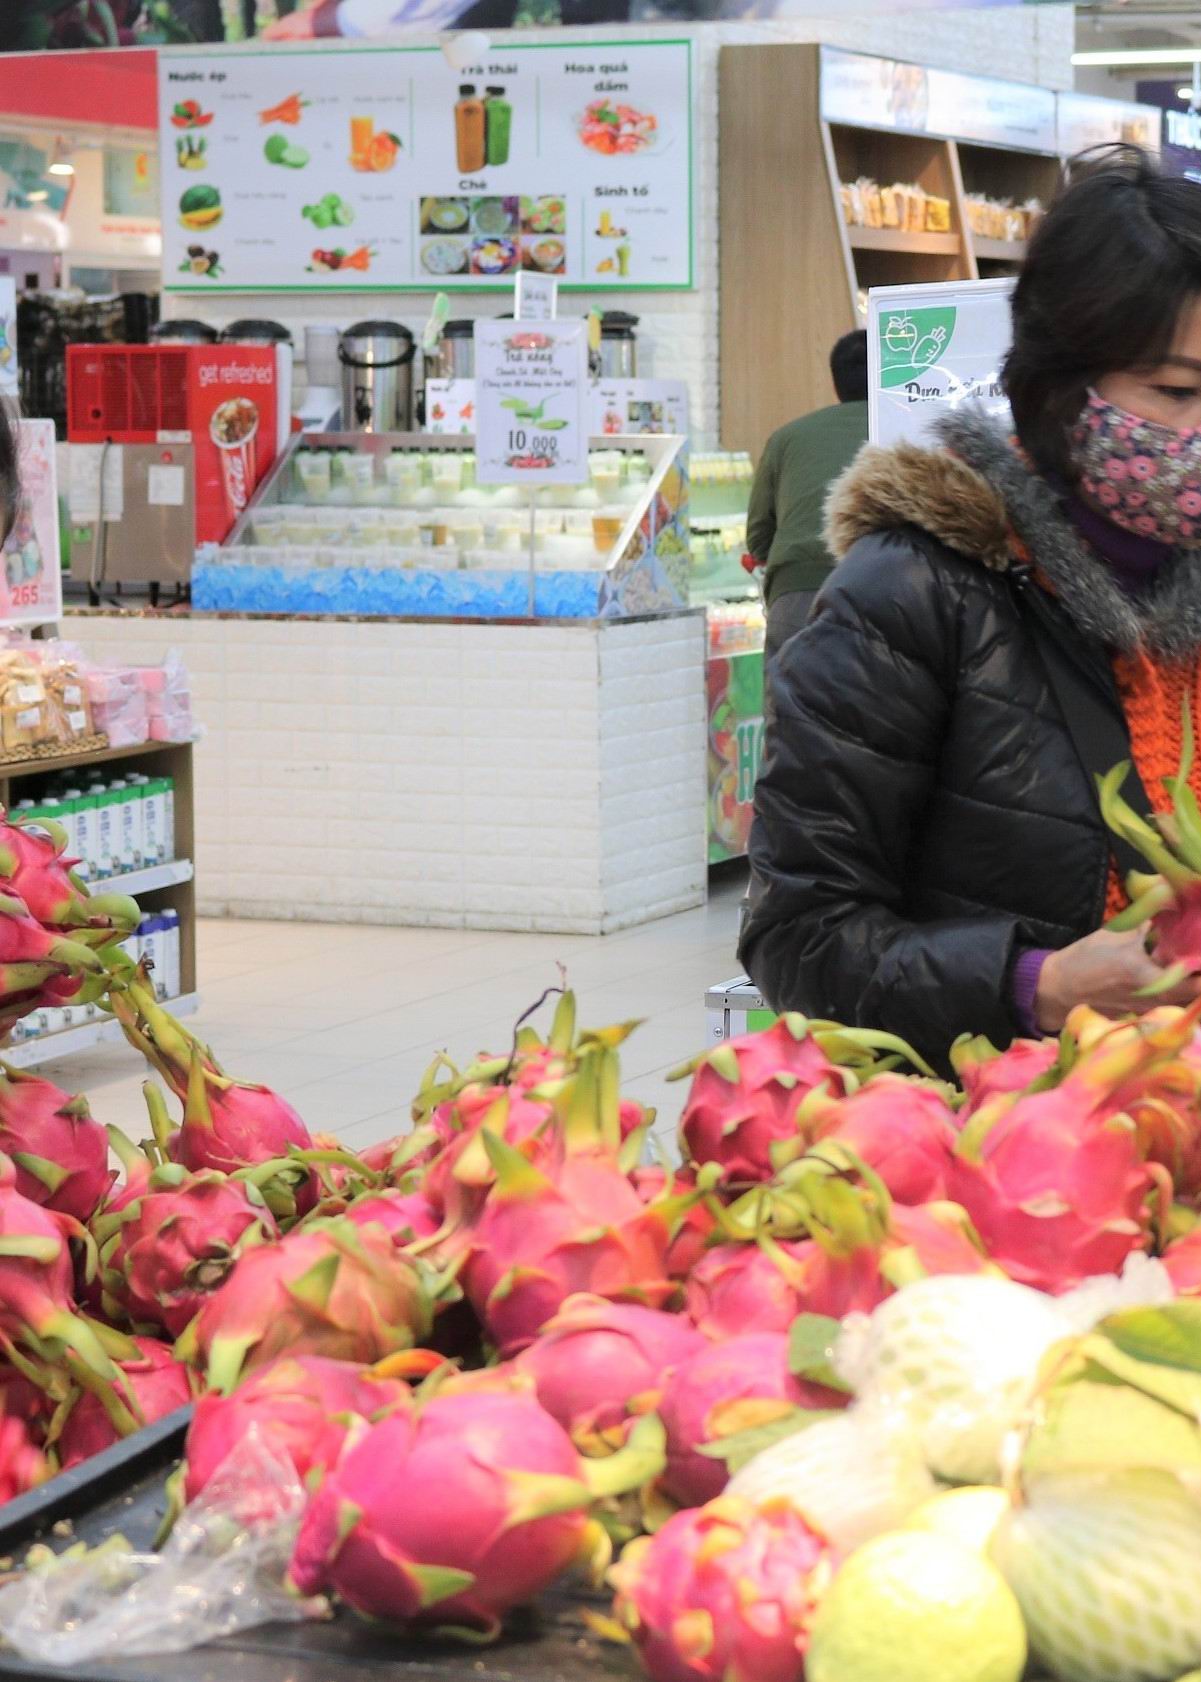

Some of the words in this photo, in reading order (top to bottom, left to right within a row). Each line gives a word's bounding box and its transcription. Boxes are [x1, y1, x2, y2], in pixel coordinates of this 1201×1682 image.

[564, 63, 595, 74] Hoa
[594, 186, 628, 197] Sinh
[198, 365, 218, 387] get
[220, 360, 273, 385] refreshed
[11, 585, 39, 606] 265
